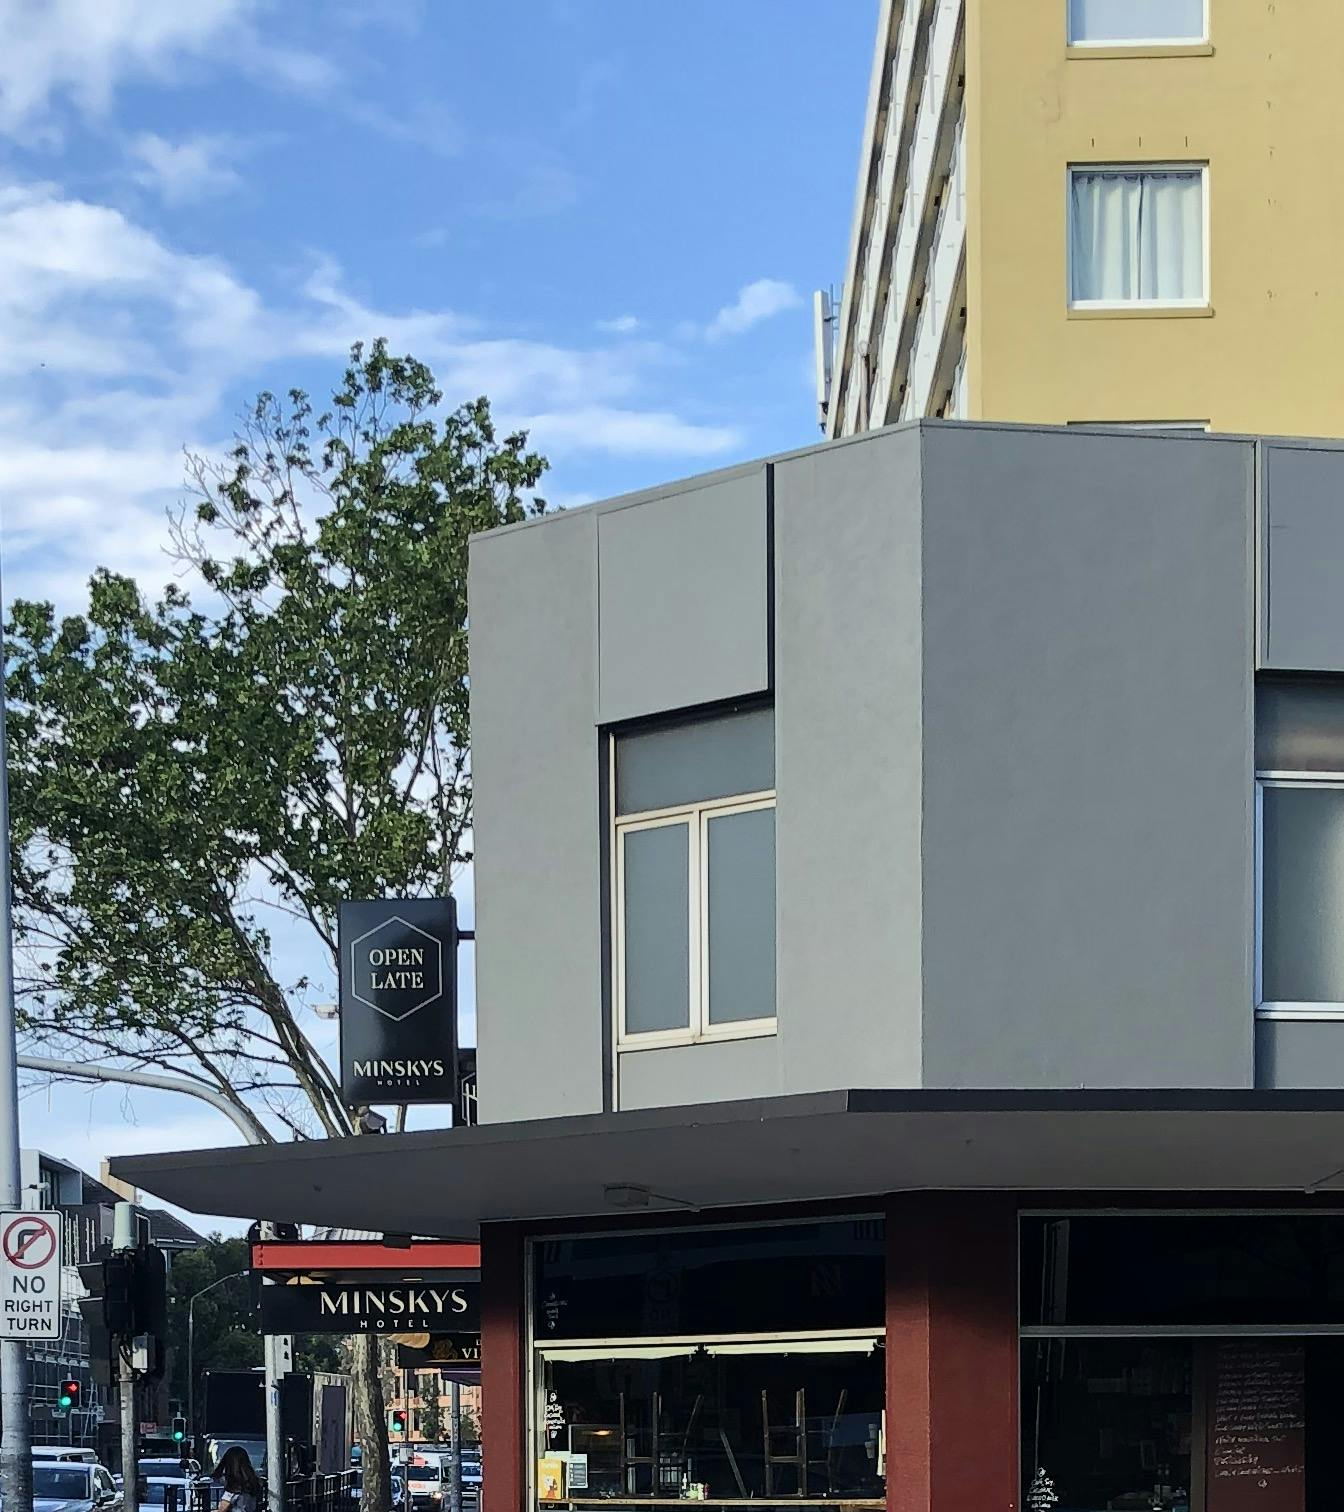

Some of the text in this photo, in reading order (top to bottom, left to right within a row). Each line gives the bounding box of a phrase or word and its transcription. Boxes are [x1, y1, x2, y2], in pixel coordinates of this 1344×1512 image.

[369, 948, 424, 966] OPEN
[370, 972, 424, 990] LATE
[353, 1060, 444, 1077] MINSKYS
[13, 1275, 45, 1294] NO
[4, 1299, 53, 1313] RIGHT
[320, 1288, 468, 1315] MINSKYS
[7, 1317, 52, 1331] TURN
[359, 1319, 429, 1329] HOTEL
